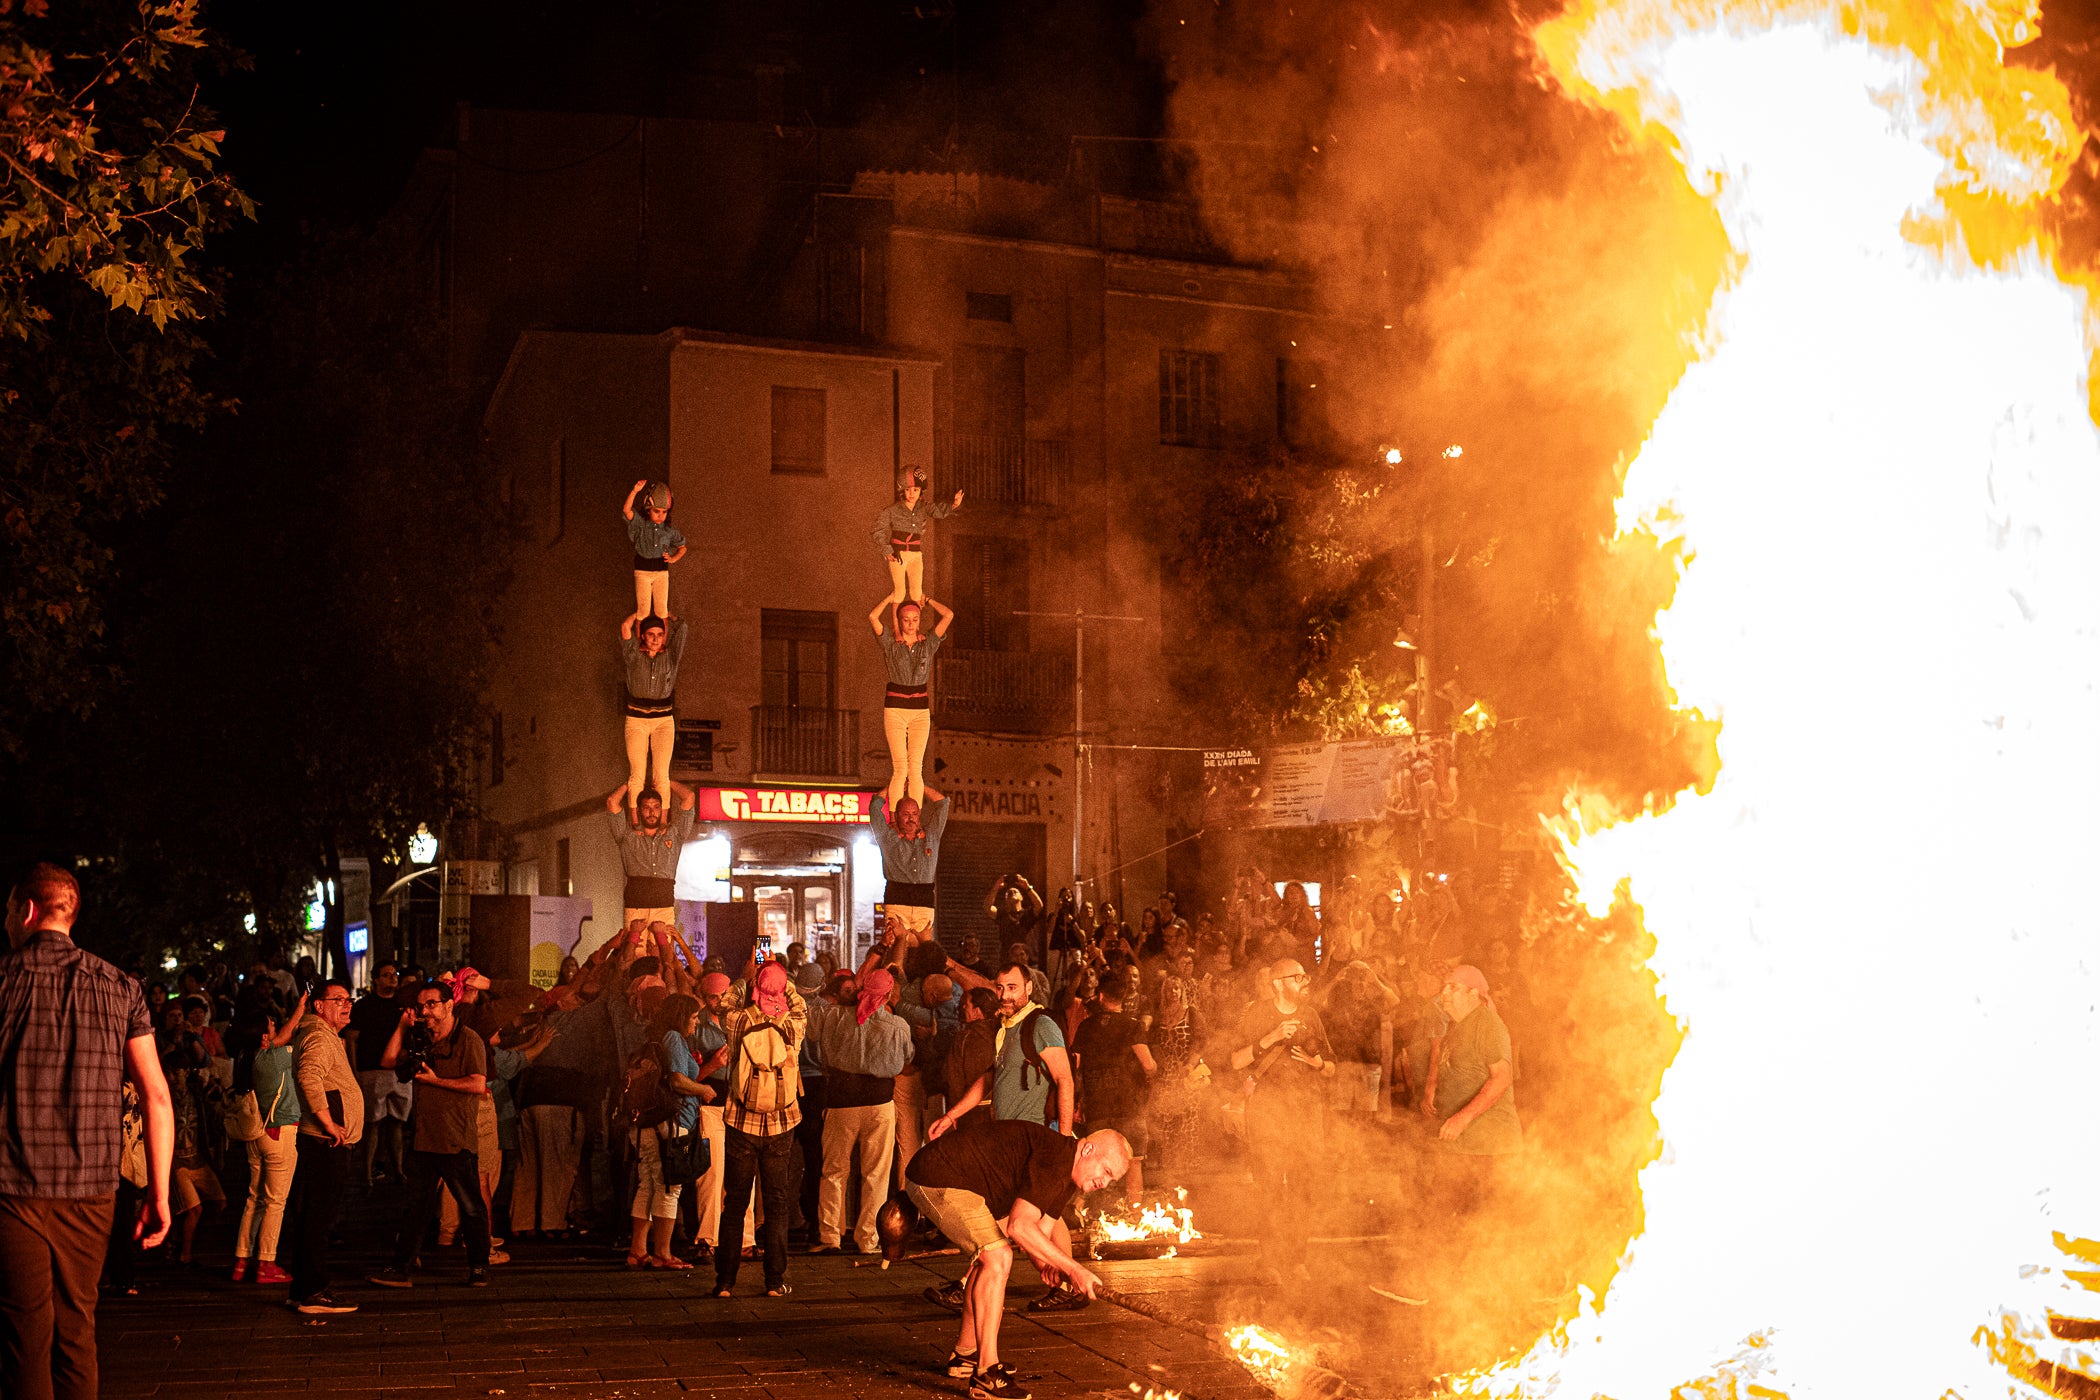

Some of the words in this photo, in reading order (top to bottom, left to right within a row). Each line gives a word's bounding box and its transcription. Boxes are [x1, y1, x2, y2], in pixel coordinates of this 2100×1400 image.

[1227, 750, 1253, 758] DIADA
[1217, 759, 1236, 767] L'AVI
[1238, 757, 1260, 766] EMILI
[757, 791, 859, 814] TABACS
[532, 969, 547, 978] CADA
